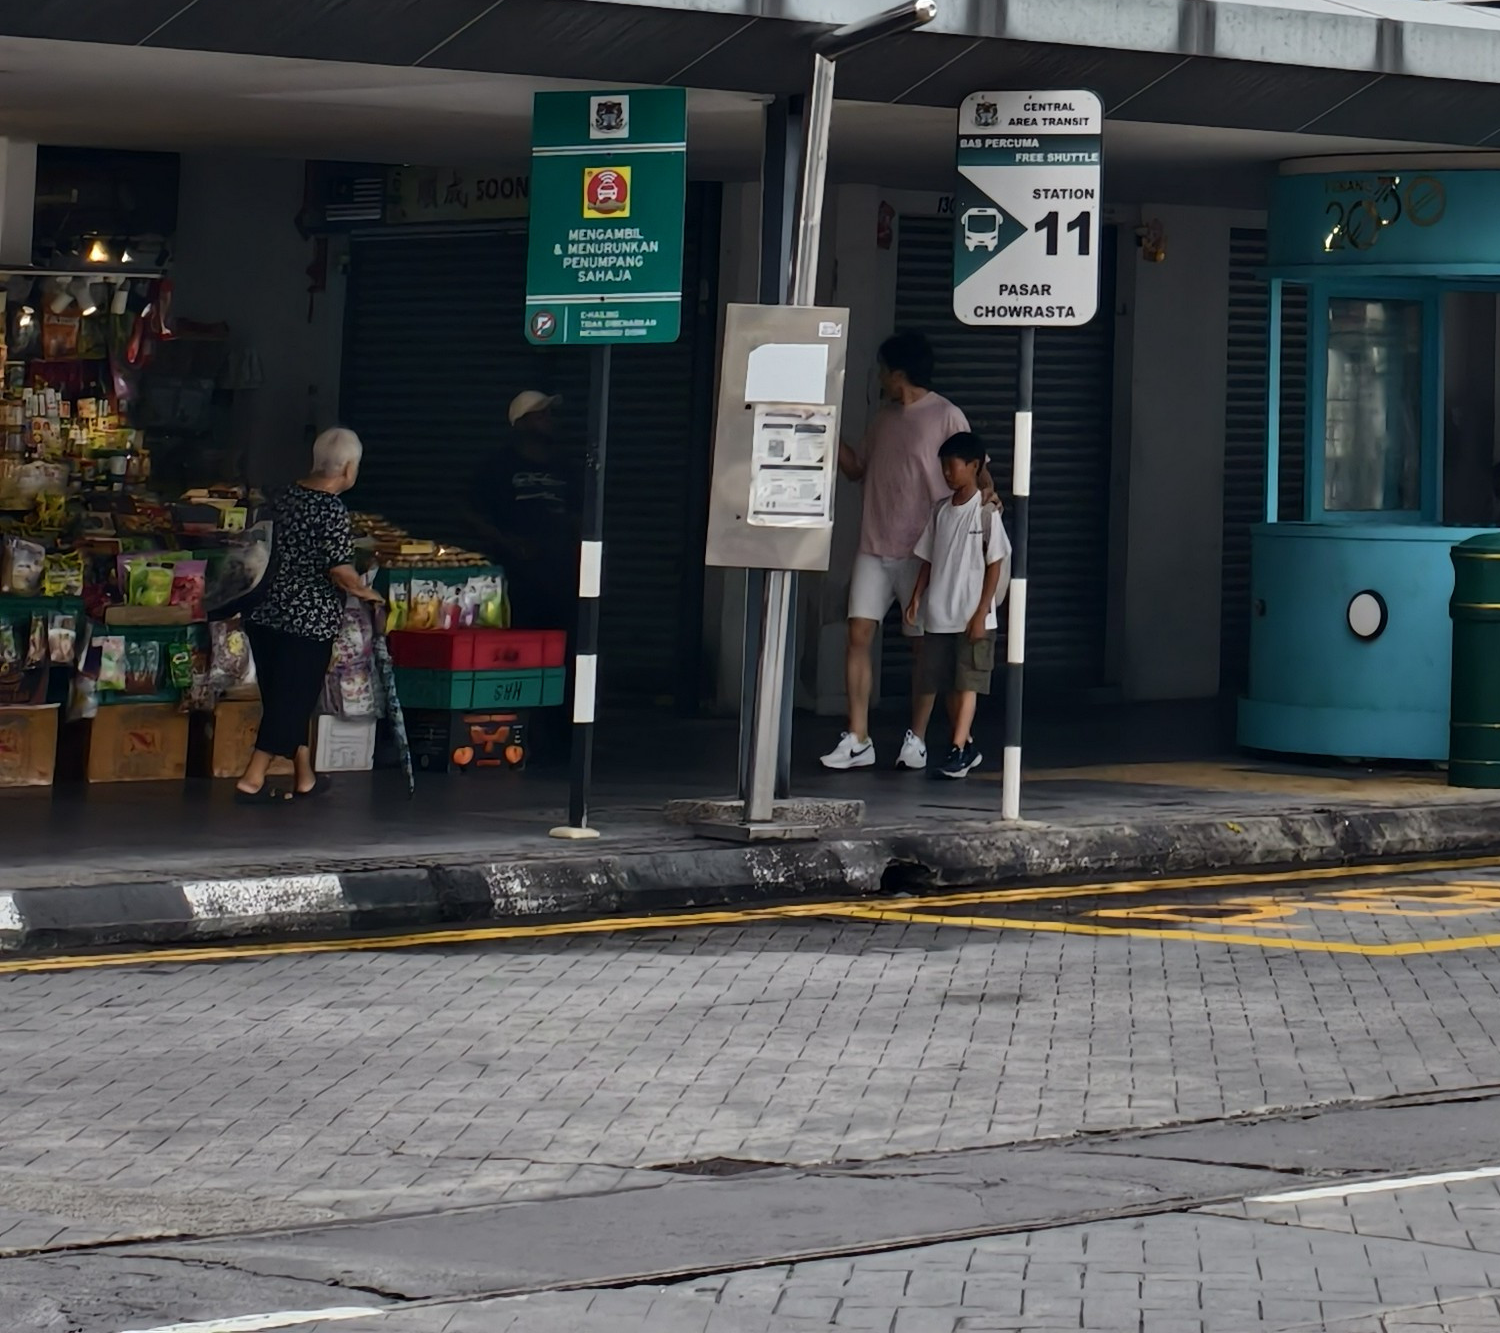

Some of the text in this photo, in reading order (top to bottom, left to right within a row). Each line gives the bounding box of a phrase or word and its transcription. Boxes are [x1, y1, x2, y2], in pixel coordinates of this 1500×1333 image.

[1024, 102, 1075, 112] CENTRAL
[1008, 117, 1090, 126] AREA TRANSIT
[960, 138, 1039, 148] BAS PERCUMA
[1015, 153, 1098, 162] FREE SHUTTLE
[1032, 188, 1095, 200] STATION
[568, 228, 644, 241] MENGAMBIL
[1034, 210, 1091, 256] 11
[567, 241, 659, 255] MENURUNKAN
[562, 255, 644, 269] PENUMPANG
[577, 269, 632, 282] SAHAJA
[999, 283, 1052, 296] PASAR
[974, 305, 1076, 318] CHOWRASTA
